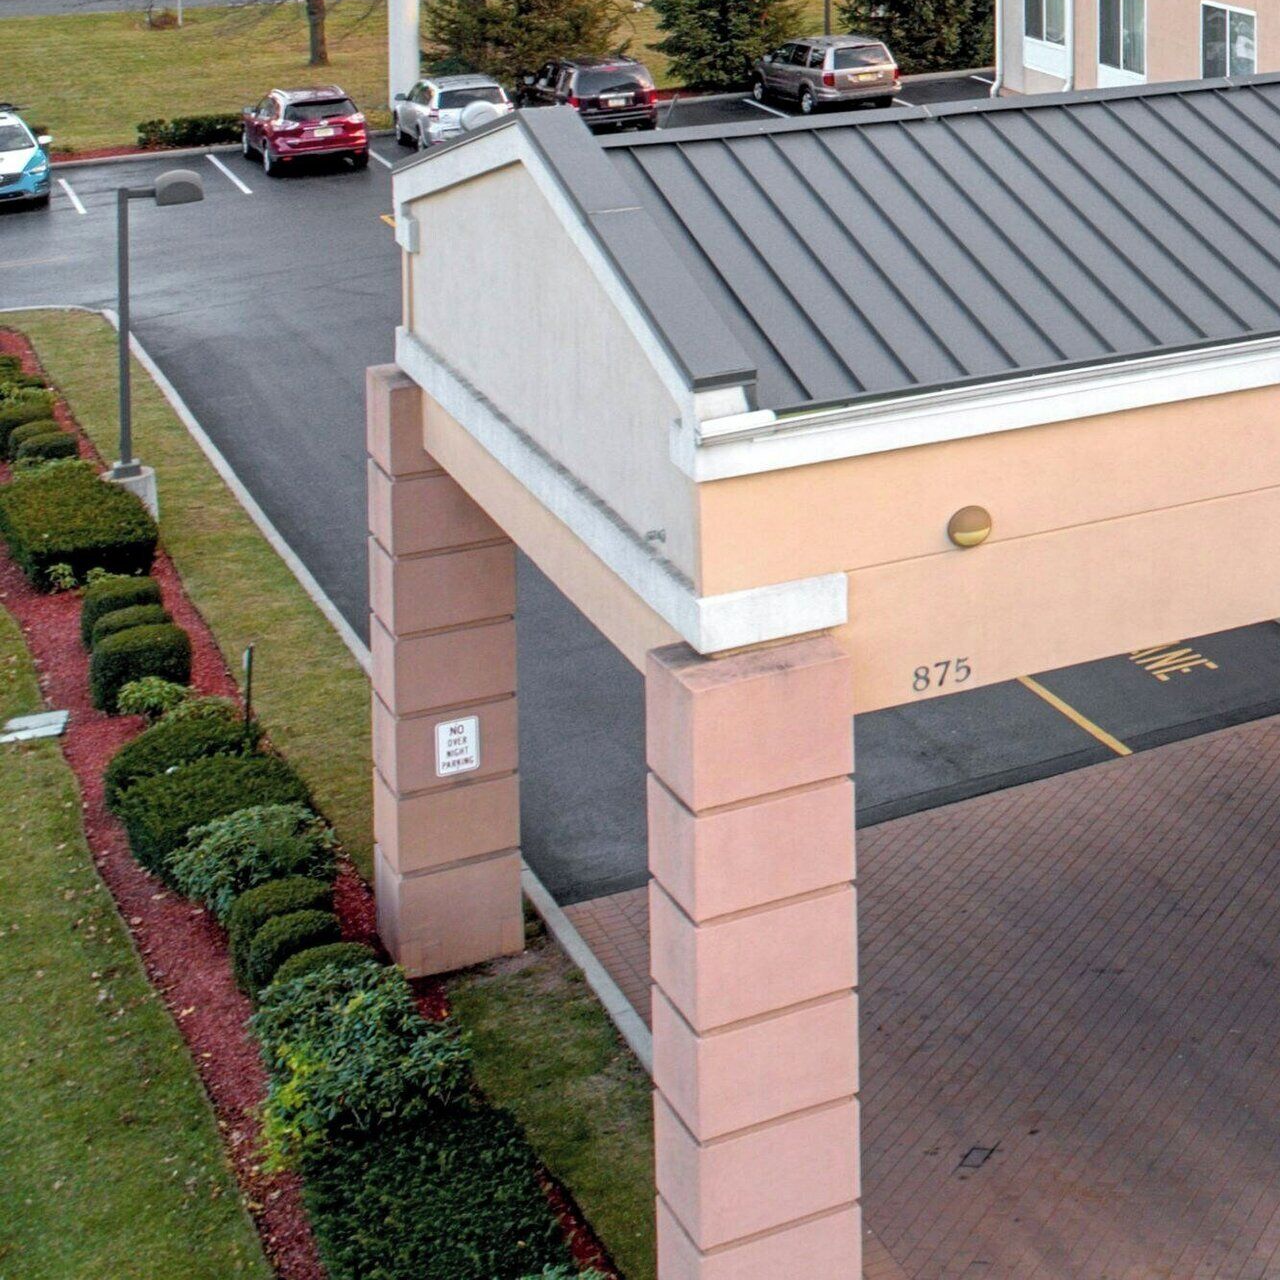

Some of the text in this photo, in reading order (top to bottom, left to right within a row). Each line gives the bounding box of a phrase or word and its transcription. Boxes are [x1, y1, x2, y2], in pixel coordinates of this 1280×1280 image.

[913, 657, 971, 691] 875
[449, 724, 464, 735] NO
[447, 736, 467, 746] OVER
[447, 746, 468, 757] NIGHT
[441, 756, 474, 769] PARKING
